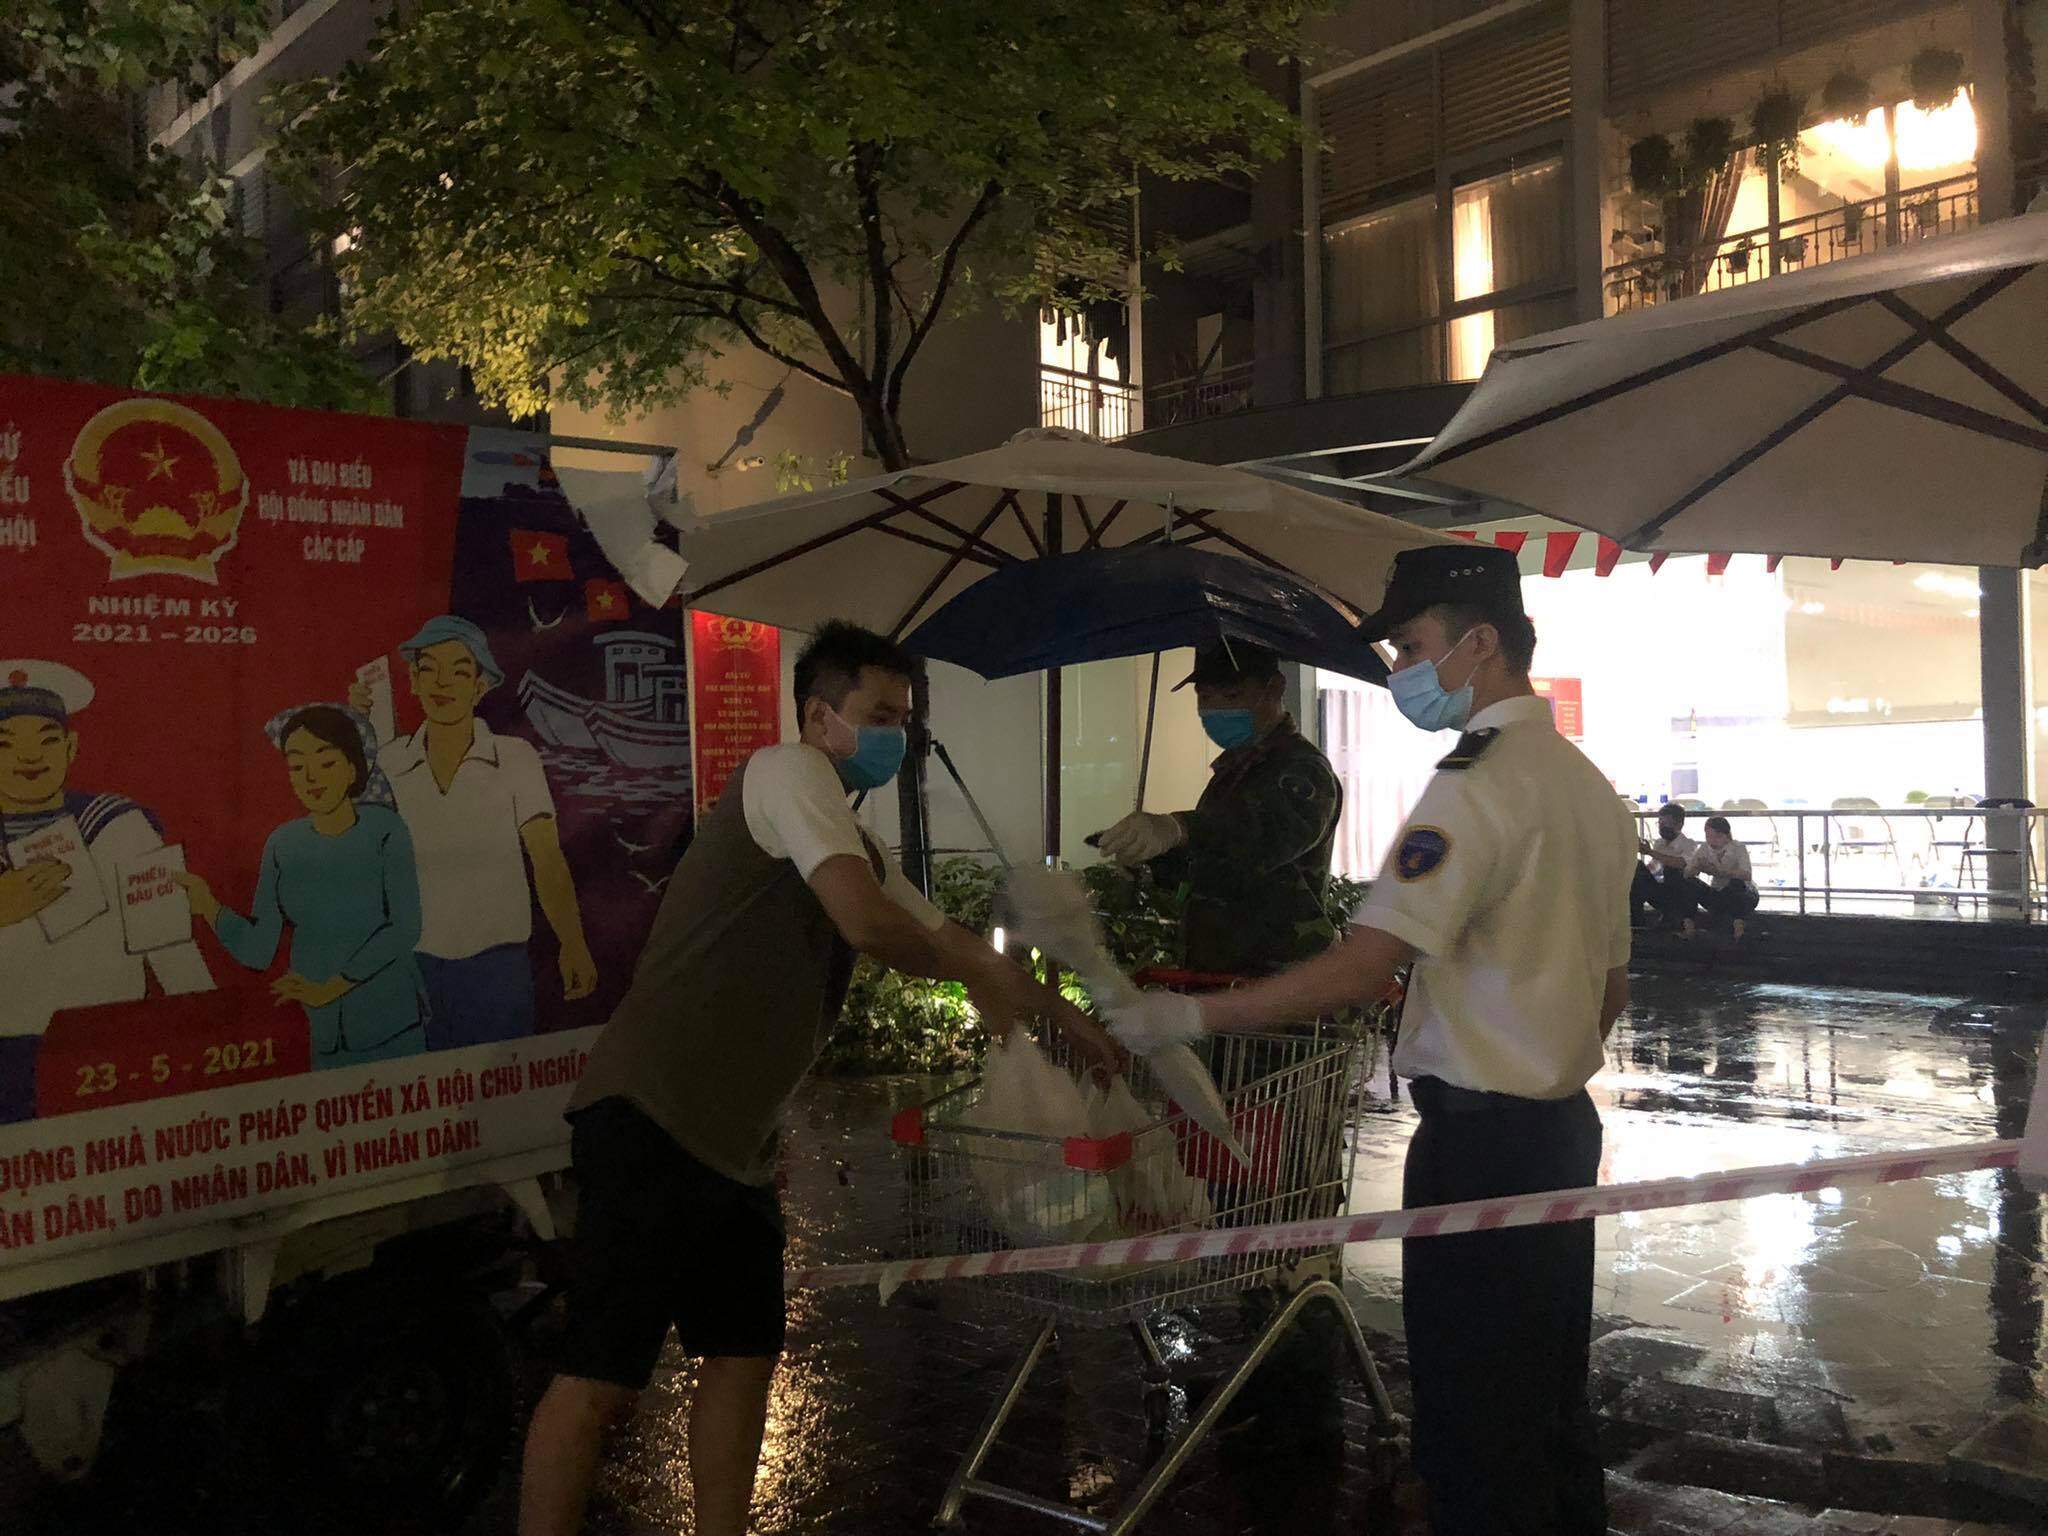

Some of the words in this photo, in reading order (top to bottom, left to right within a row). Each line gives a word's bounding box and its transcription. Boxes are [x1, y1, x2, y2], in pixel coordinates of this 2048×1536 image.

[72, 623, 152, 643] 2021
[184, 626, 257, 645] 2026
[88, 594, 190, 622] NHIỆM
[75, 1061, 118, 1097] 23
[151, 1053, 172, 1085] 5
[203, 1037, 277, 1075] 2021
[85, 1125, 146, 1176] NHÀ
[155, 1111, 231, 1163] NƯỚC
[240, 1100, 307, 1146] PHÁP
[400, 1075, 431, 1116] XÃ
[437, 1068, 474, 1114] HỘI
[480, 1050, 523, 1099] CHỦ
[43, 1194, 117, 1241] DÂN,
[124, 1183, 162, 1224] DO
[171, 1163, 248, 1213] NHÂN
[256, 1151, 317, 1195] DÂN,
[323, 1139, 347, 1180] VÌ
[354, 1128, 419, 1174] NHÂN
[426, 1118, 481, 1159] DÂN!
